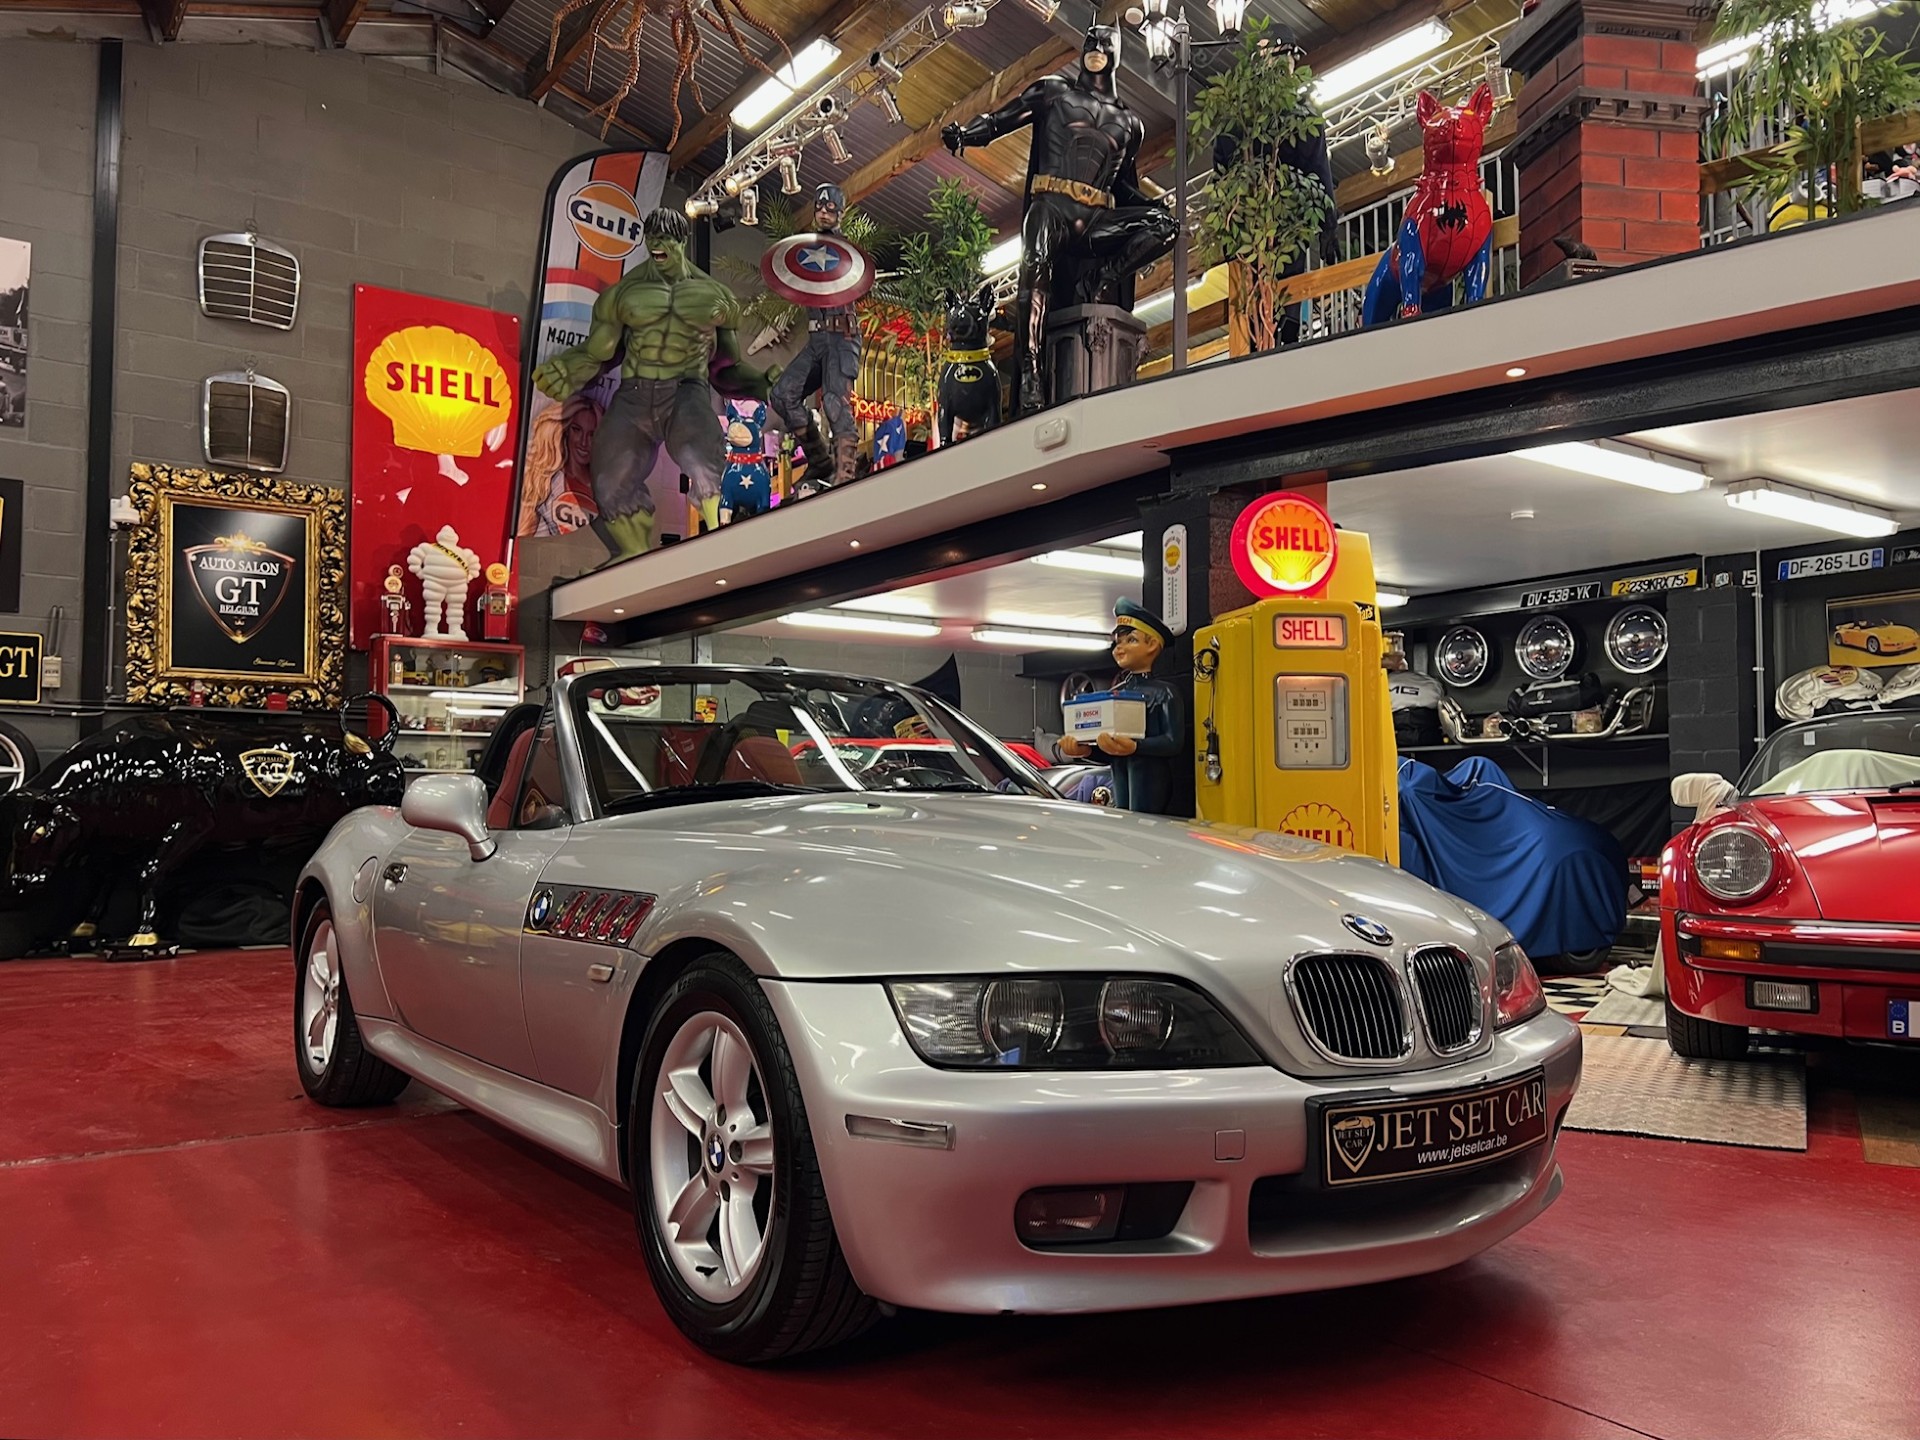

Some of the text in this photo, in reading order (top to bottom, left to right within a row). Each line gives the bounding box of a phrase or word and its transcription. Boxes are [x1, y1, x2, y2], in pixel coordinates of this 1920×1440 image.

[571, 199, 642, 241] Gulf
[546, 326, 589, 347] MART
[386, 361, 500, 408] SHELL
[1258, 526, 1324, 552] SHELL
[199, 556, 280, 574] AUTO SALON
[1790, 552, 1869, 575] DF-265-LG
[214, 576, 267, 605] GT
[219, 604, 259, 615] BELGIUM
[1282, 620, 1336, 640] SHELL
[0, 646, 35, 678] GT
[1083, 710, 1099, 718] BOSCH
[1892, 1020, 1905, 1034] B
[1376, 1081, 1545, 1152] JET SET CAR
[1338, 1128, 1372, 1140] JET SET
[1345, 1139, 1364, 1149] CAR
[1417, 1134, 1508, 1165] www.jetsetcar.be
